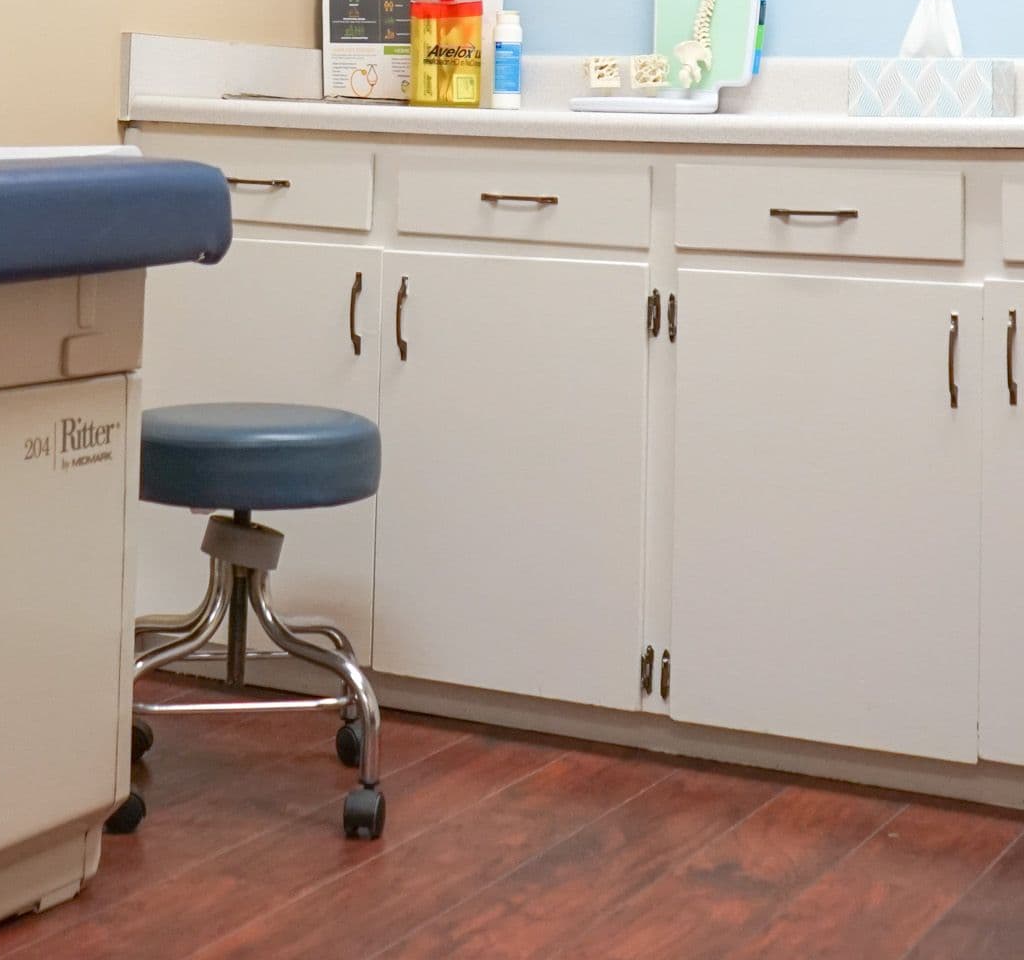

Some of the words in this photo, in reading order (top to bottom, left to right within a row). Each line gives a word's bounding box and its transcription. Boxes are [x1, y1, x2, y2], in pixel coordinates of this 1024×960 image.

[428, 44, 473, 58] Avelox
[61, 417, 114, 453] Ritter
[24, 436, 50, 460] 204
